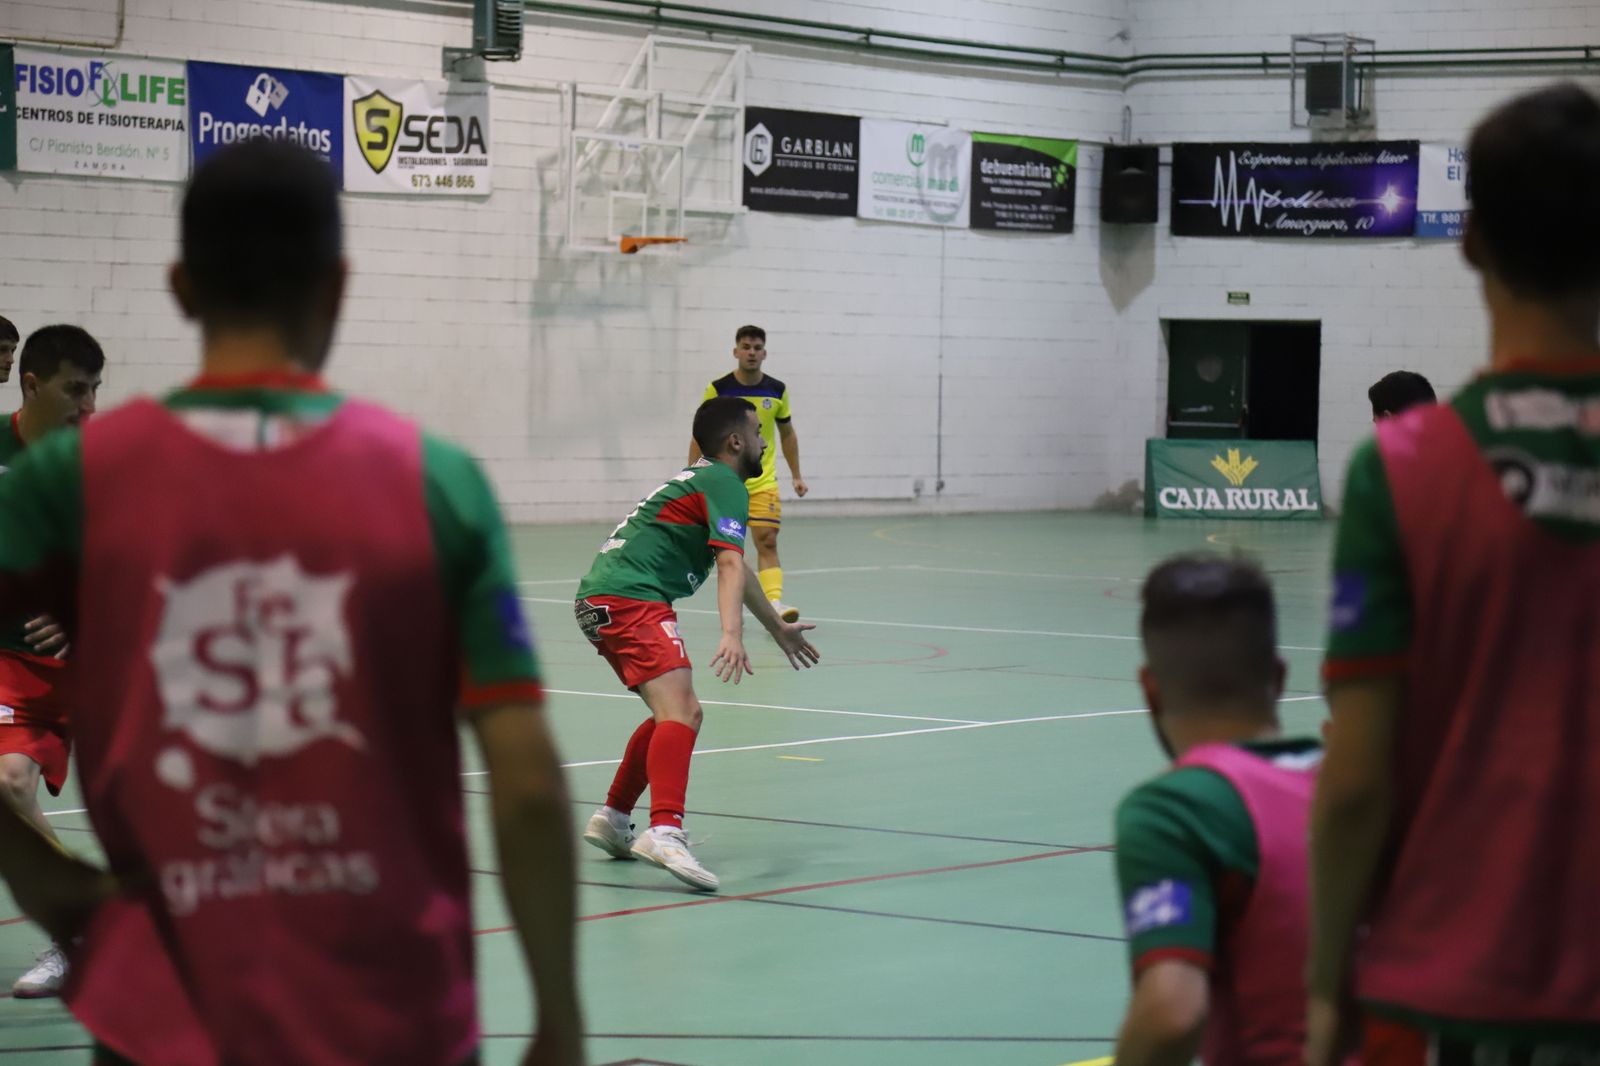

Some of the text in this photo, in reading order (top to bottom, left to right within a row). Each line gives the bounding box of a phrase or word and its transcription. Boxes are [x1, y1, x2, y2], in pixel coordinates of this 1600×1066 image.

[15, 63, 85, 97] FISIO
[120, 73, 186, 106] LIFE
[16, 107, 74, 124] CENTROS
[77, 112, 95, 125] DE
[98, 113, 186, 132] FISIOTERAPIA
[397, 114, 487, 154] SEDA
[29, 137, 44, 152] C/
[47, 138, 94, 156] Pianista
[781, 136, 854, 158] GARBLAN
[74, 161, 126, 171] ZAMORA
[980, 157, 1052, 179] debuenatinta
[411, 174, 432, 188] 673
[672, 639, 685, 658] 7
